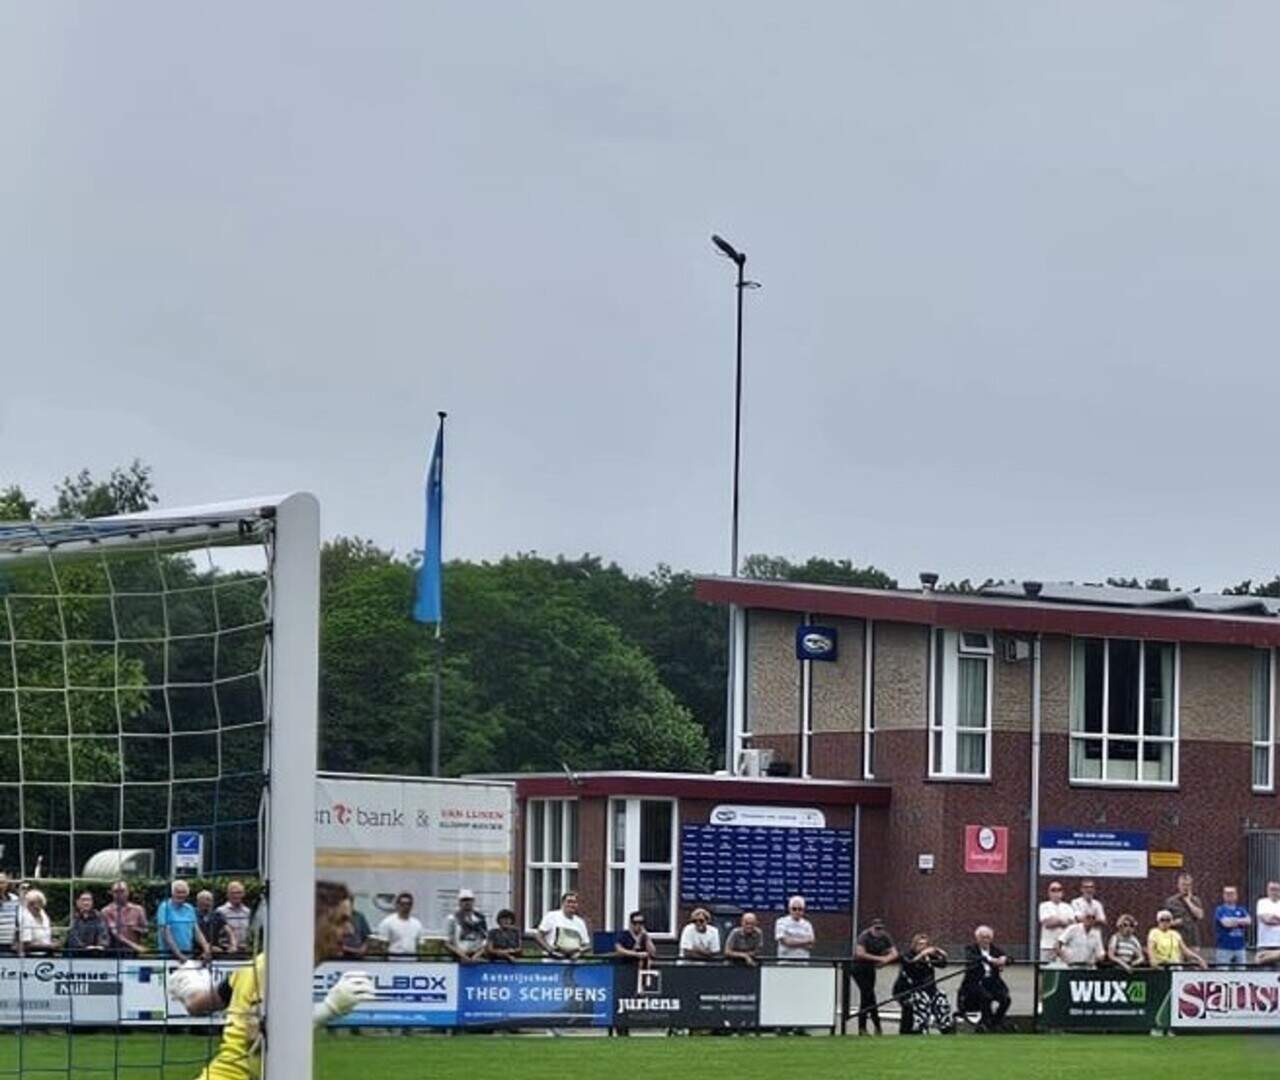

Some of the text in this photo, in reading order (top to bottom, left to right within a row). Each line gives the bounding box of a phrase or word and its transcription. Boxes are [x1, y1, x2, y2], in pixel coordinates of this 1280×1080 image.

[356, 806, 405, 827] bank
[415, 810, 430, 827] &
[465, 986, 511, 1002] THEO
[518, 986, 608, 1002] SCHEPENS
[1069, 980, 1129, 1004] WUX
